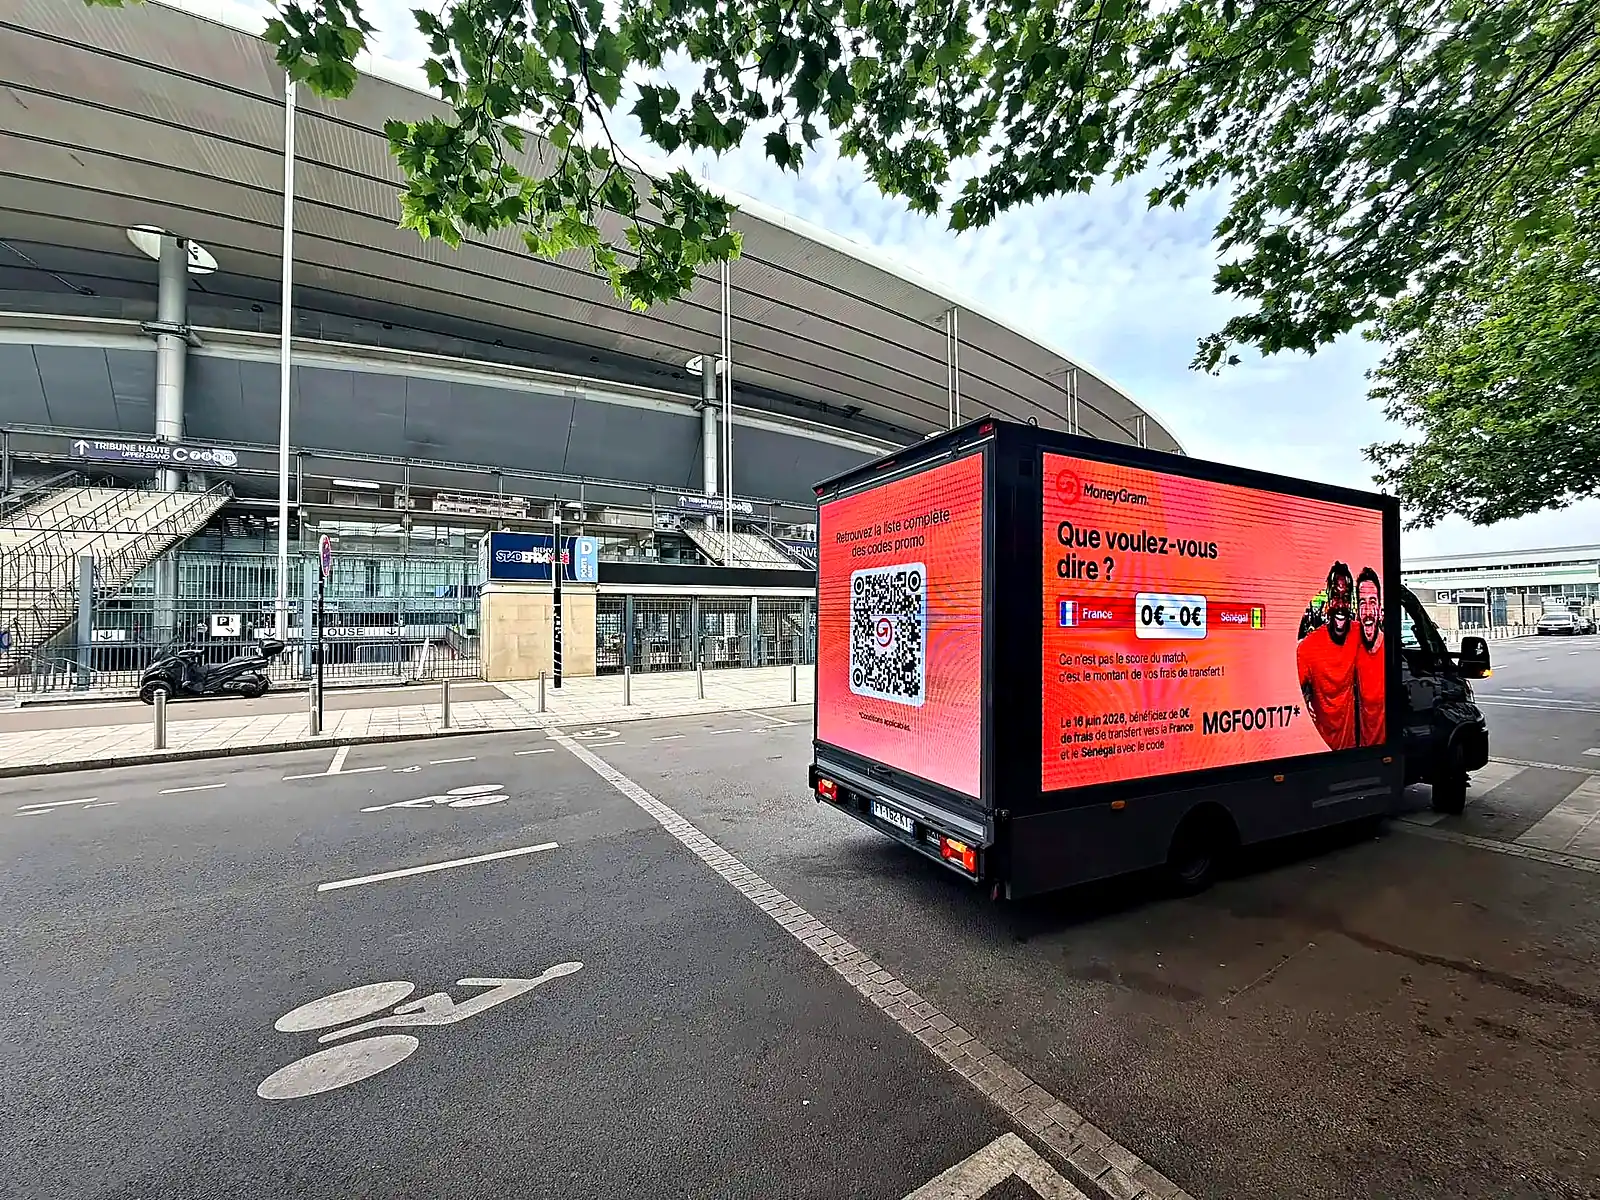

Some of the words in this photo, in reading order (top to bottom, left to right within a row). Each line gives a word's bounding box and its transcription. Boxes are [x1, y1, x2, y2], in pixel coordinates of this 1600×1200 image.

[94, 442, 136, 452] TRIBUNE
[138, 445, 170, 454] HAUTE
[173, 448, 188, 461] C
[121, 451, 145, 459] UPPER
[836, 526, 872, 544] Retrouvez
[874, 524, 881, 536] la
[884, 520, 901, 534] liste
[904, 508, 950, 530] complète
[581, 541, 592, 554] D
[852, 545, 866, 557] des
[867, 541, 892, 555] codes
[895, 535, 924, 552] promo
[1057, 520, 1100, 548] Que
[1105, 530, 1218, 559] voulez-vous
[1056, 553, 1098, 580] dire
[1102, 556, 1114, 580] ?
[1082, 608, 1112, 619] France
[1141, 604, 1164, 626] 0€
[1179, 606, 1202, 626] 0€
[1220, 611, 1249, 624] Sénégal
[1059, 653, 1072, 666] Ce
[1075, 653, 1096, 665] n'est
[1098, 654, 1113, 667] pas
[1116, 653, 1123, 664] le
[1126, 655, 1148, 664] score
[1150, 652, 1161, 663] du
[1162, 652, 1188, 665] match,
[1059, 671, 1080, 683] c'est
[1083, 670, 1091, 682] le
[1094, 669, 1128, 681] montant
[1131, 668, 1142, 680] de
[1144, 671, 1158, 679] vos
[1160, 668, 1176, 679] frais
[1178, 667, 1188, 678] de
[1190, 666, 1220, 678] transfert
[1060, 717, 1071, 728] Le
[1073, 716, 1083, 727] 16
[1085, 714, 1101, 728] juin
[1103, 713, 1127, 725] 2026,
[1129, 711, 1167, 723] bénéficiez
[1168, 709, 1178, 720] de
[1180, 708, 1190, 718] 0€
[1061, 733, 1072, 744] de
[1074, 732, 1093, 742] frais
[1095, 730, 1106, 741] de
[1108, 727, 1141, 739] transfert
[1143, 725, 1159, 736] vers
[1161, 724, 1167, 734] la
[1169, 723, 1194, 733] France
[1061, 750, 1069, 760] et
[1071, 749, 1078, 758] le
[1081, 745, 1116, 758] Sénégal
[1117, 743, 1136, 753] avec
[1138, 741, 1144, 751] le
[1146, 739, 1164, 751] code
